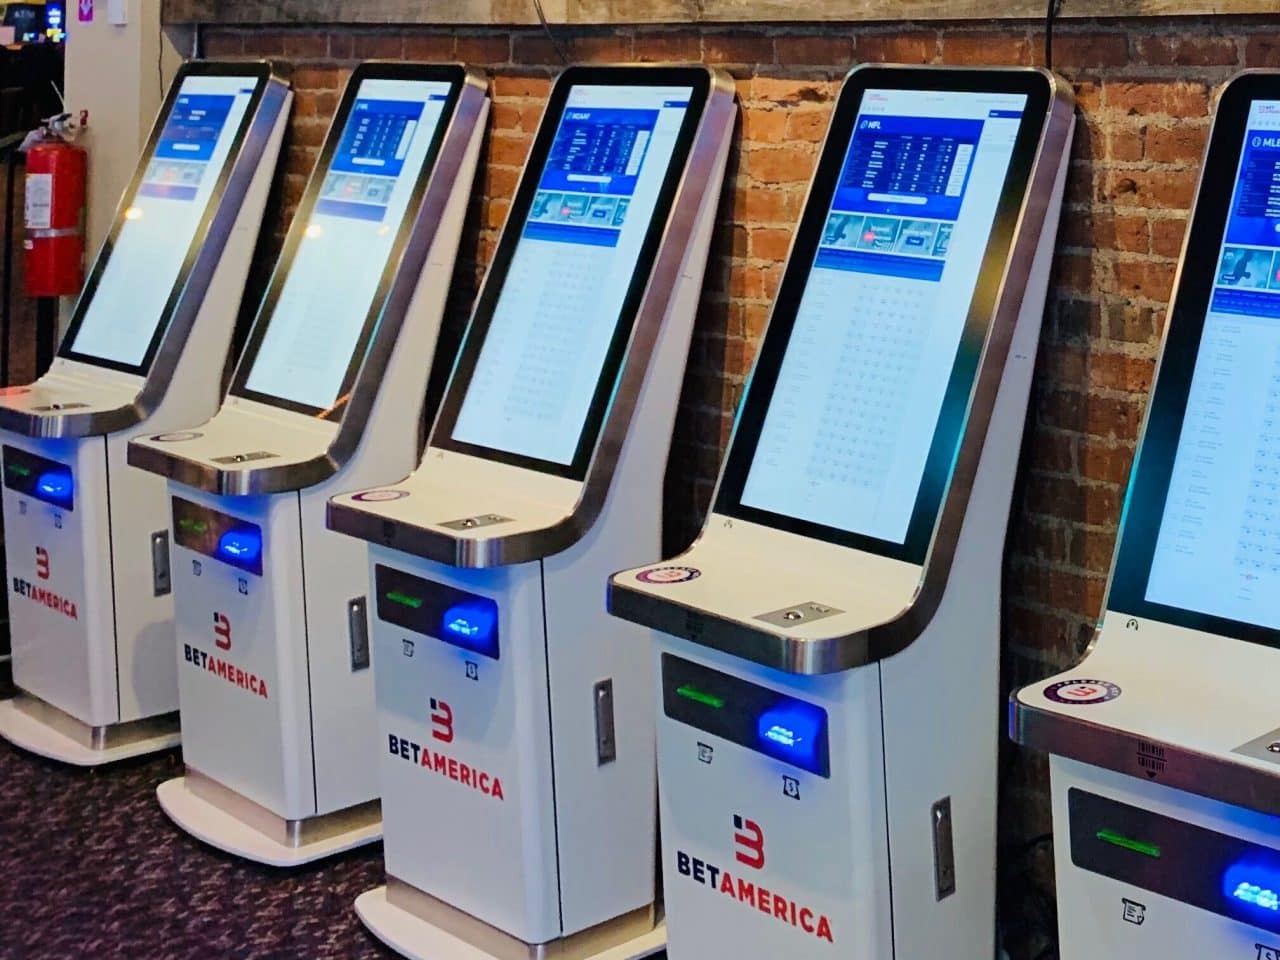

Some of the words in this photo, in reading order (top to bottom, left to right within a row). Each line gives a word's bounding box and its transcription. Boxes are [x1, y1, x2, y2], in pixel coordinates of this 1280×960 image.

[13, 576, 78, 621] BETAMERICA
[184, 643, 268, 699] BETAMERICA
[388, 734, 504, 801] BETAMERICA
[677, 850, 834, 943] BETAMERICA
